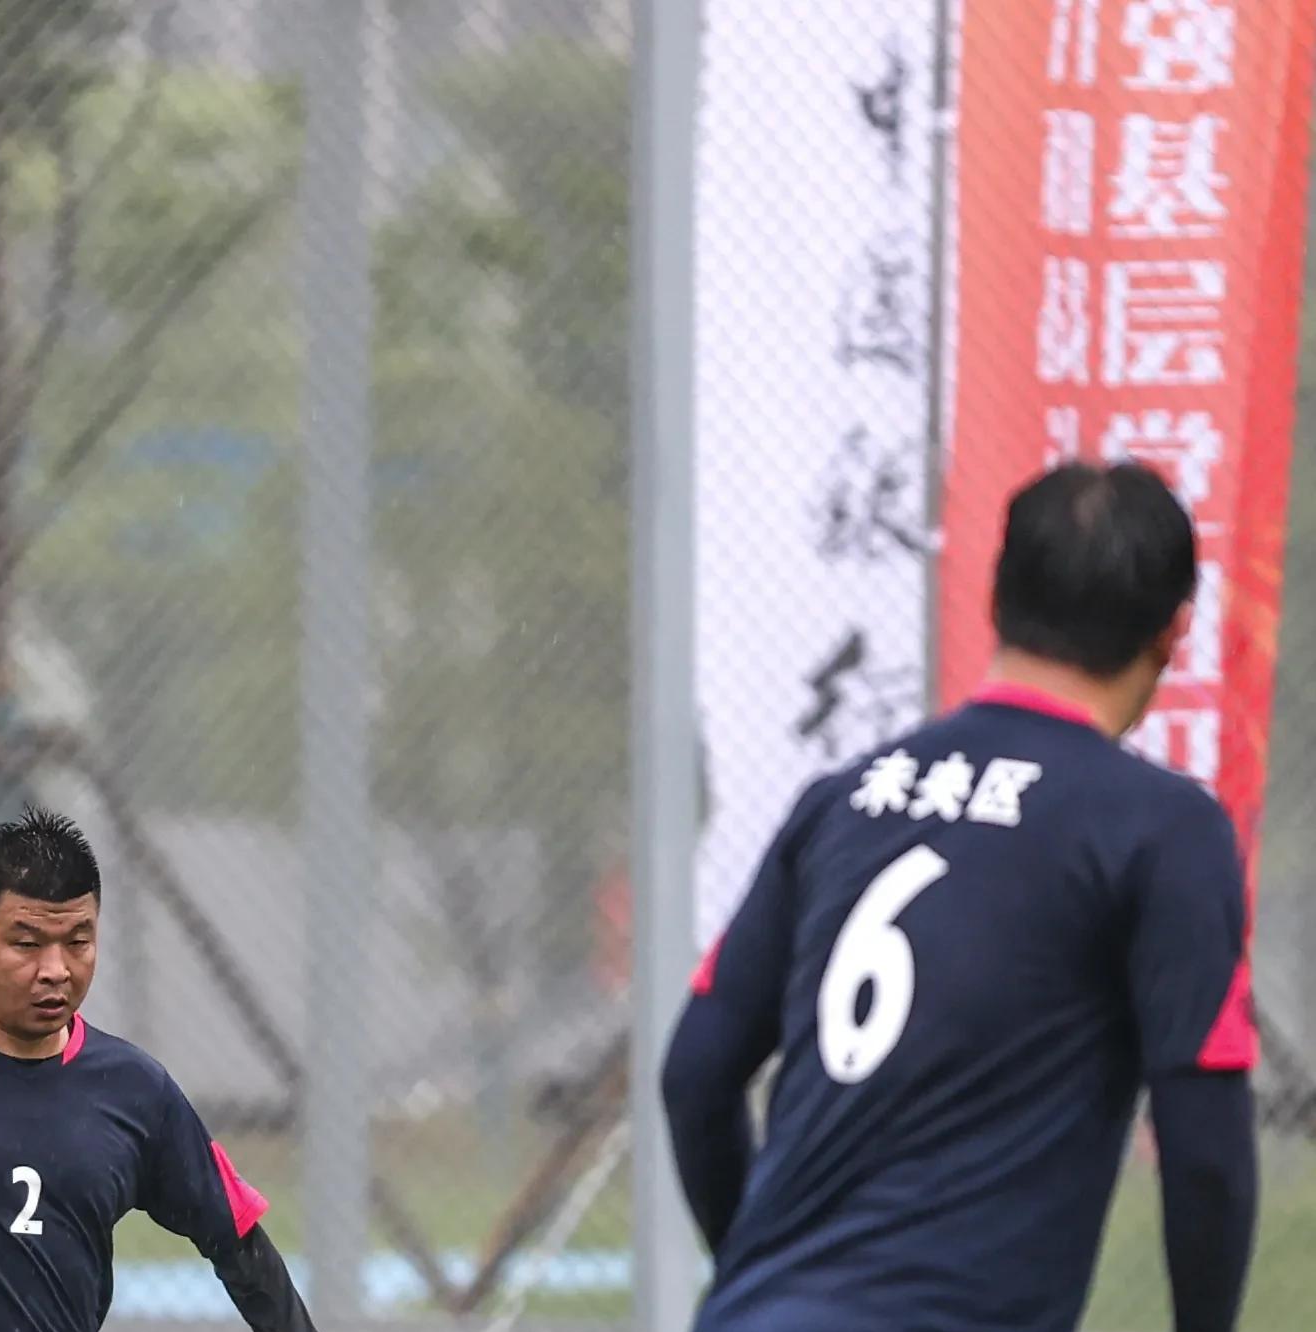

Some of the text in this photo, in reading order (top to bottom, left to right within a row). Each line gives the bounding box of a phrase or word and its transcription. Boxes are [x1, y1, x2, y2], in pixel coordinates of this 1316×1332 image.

[850, 748, 1043, 827] 未央区
[817, 843, 950, 1085] 6
[9, 1165, 44, 1236] 2
